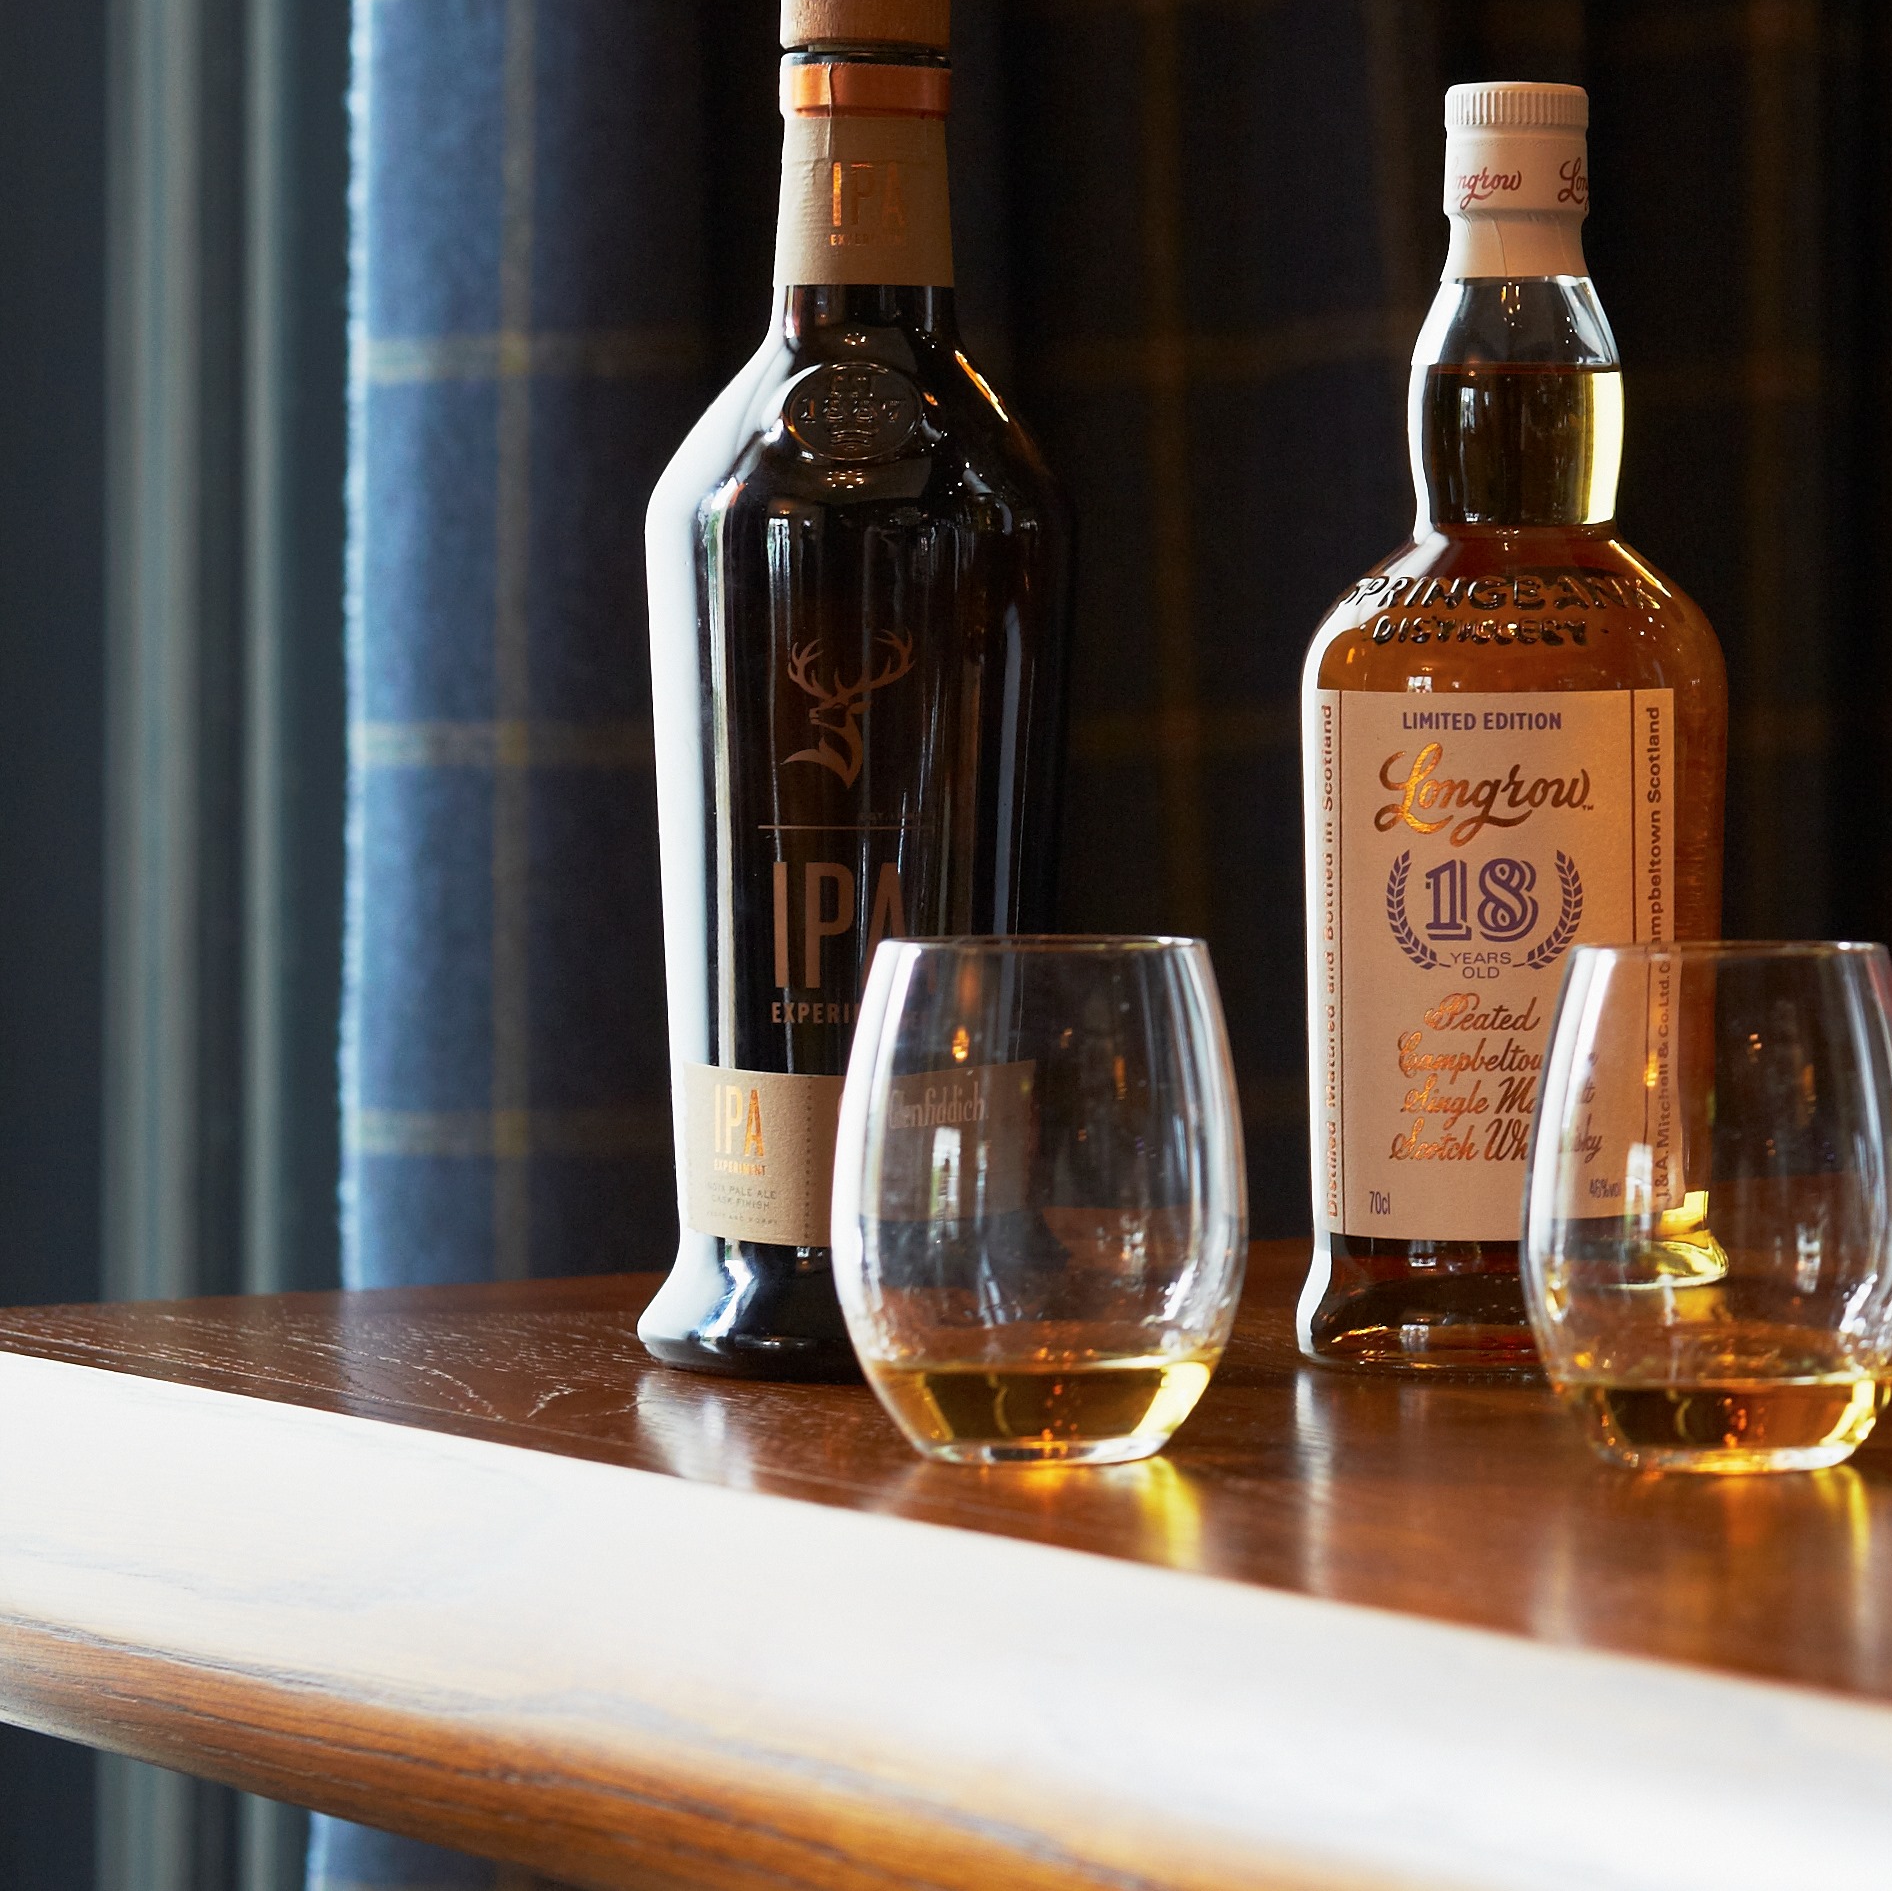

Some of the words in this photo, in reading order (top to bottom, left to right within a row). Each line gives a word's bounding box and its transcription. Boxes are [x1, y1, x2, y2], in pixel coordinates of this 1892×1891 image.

[832, 162, 906, 226] IPA
[1342, 574, 1667, 609] SPRINGBANK
[1372, 614, 1588, 646] DISTILLERY
[1403, 711, 1476, 731] LIMITED
[1483, 712, 1562, 730] EDITION
[1321, 705, 1333, 812] Scotland
[1646, 706, 1662, 803] Scotland
[1374, 741, 1591, 848] Longrow
[1323, 821, 1333, 843] in
[1425, 857, 1539, 943] 18
[773, 861, 908, 991] IPA
[1450, 952, 1513, 965] YEARS
[1462, 967, 1500, 979] OLD
[771, 1001, 862, 1024] EXPERI
[1424, 992, 1541, 1031] Peated
[1397, 1031, 1556, 1085] Campbeltow
[714, 1083, 765, 1158] IPA
[1400, 1073, 1489, 1130] Single
[1656, 1063, 1671, 1149] Mitchell
[1389, 1117, 1479, 1162] Scotch
[714, 1158, 766, 1176] EXPERIMENT
[1369, 1190, 1391, 1216] 70cl
